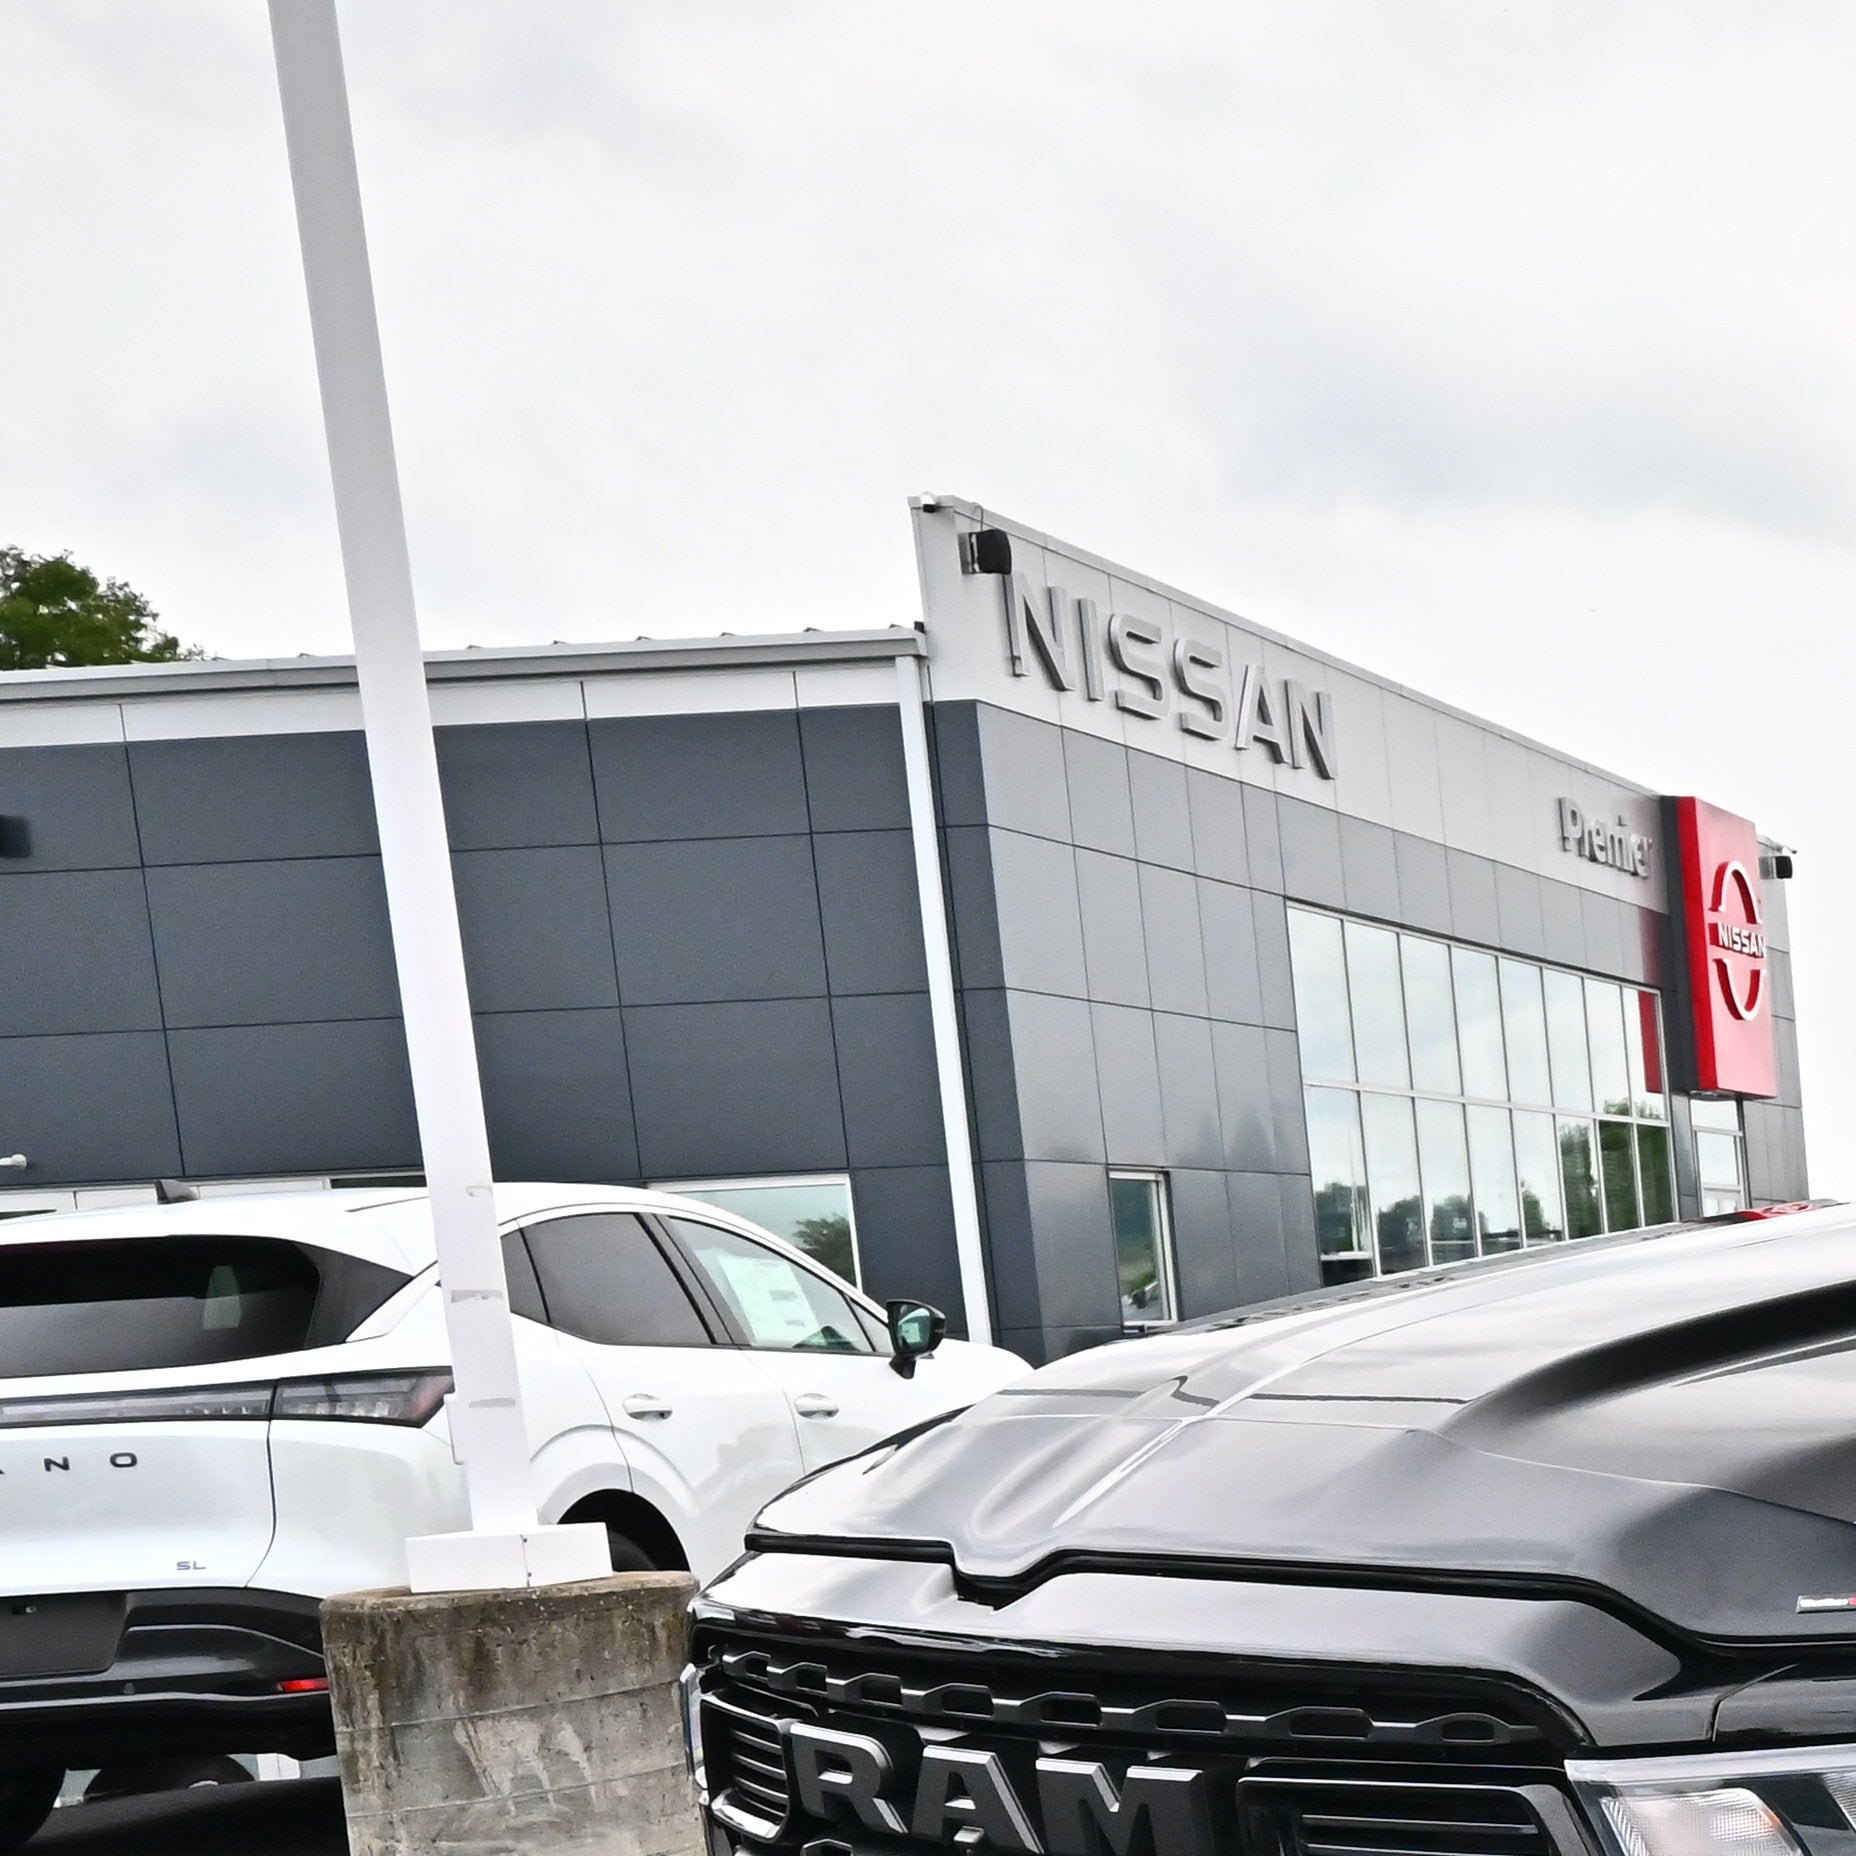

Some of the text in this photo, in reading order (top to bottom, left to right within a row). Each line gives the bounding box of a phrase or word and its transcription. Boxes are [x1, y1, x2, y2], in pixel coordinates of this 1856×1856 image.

[1002, 572, 1336, 780] NISSAN
[1716, 921, 1767, 959] NISSAN
[176, 1560, 207, 1571] SL
